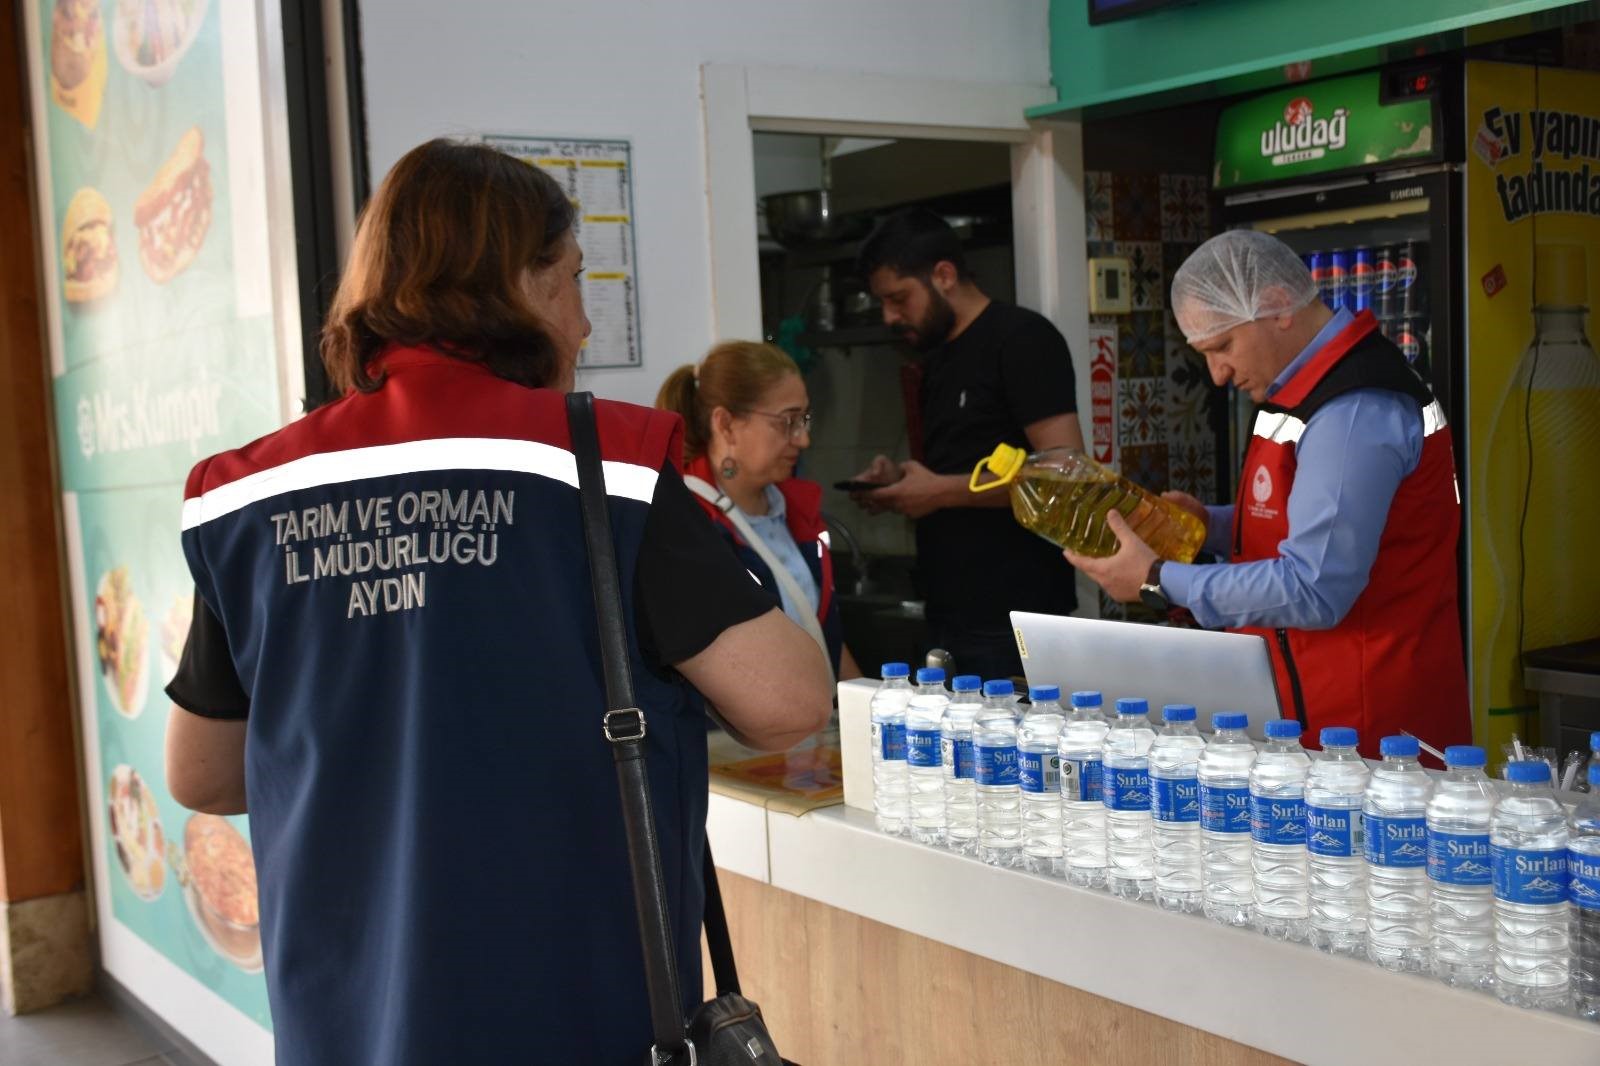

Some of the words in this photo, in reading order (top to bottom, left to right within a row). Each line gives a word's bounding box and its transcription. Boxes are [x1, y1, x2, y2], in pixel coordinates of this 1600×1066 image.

[1261, 109, 1347, 156] uludağ
[1497, 162, 1600, 221] tadında
[270, 500, 350, 545] TARIM
[356, 496, 393, 531] VE
[398, 488, 515, 526] ORMAN
[285, 544, 311, 585] İL
[313, 521, 499, 580] MÜDÜRLÜĞÜ
[347, 571, 427, 619] AYDIN
[1116, 772, 1149, 788] Şırla
[1271, 803, 1306, 819] Şırla
[1387, 823, 1425, 841] Şırla
[1447, 839, 1488, 858] Şırla
